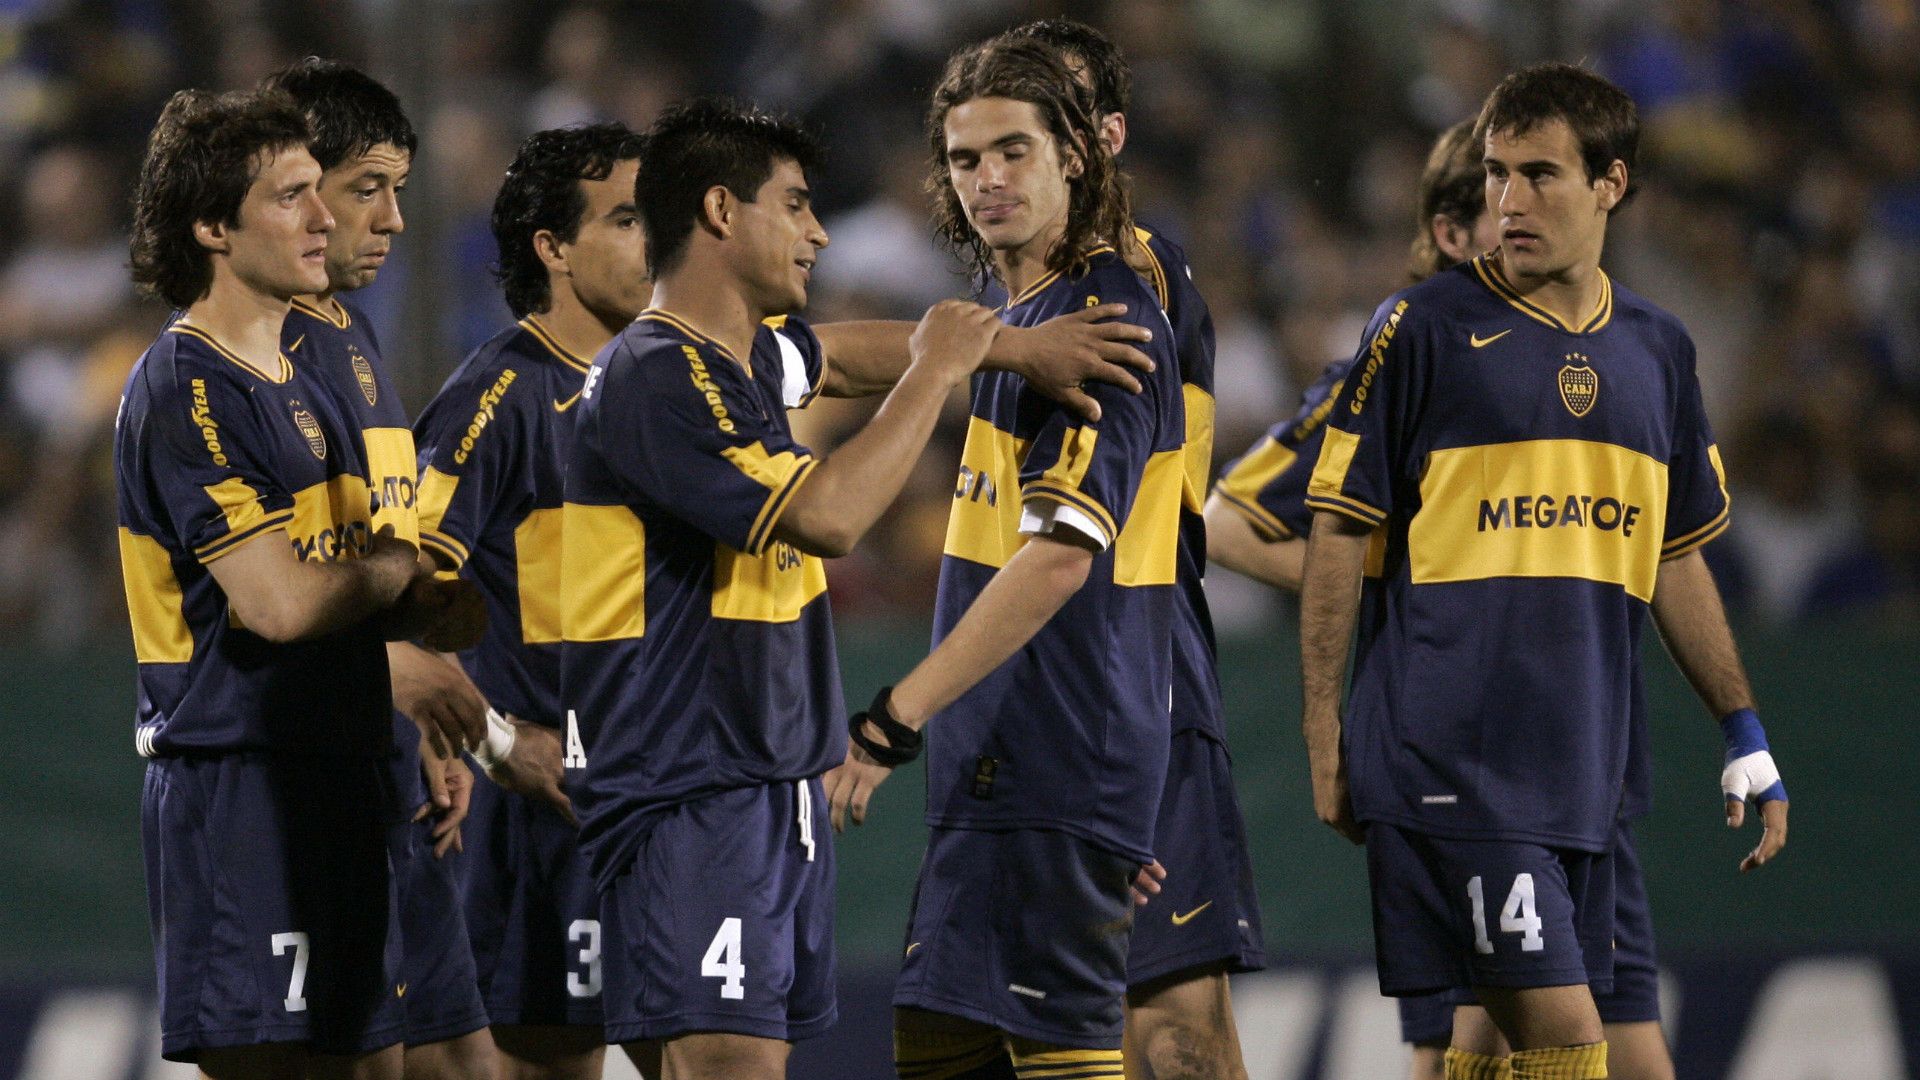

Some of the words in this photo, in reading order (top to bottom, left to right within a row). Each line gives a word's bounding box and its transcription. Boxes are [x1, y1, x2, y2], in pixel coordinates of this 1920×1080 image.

[682, 344, 739, 434] OODYEAR
[1350, 300, 1409, 415] GOODYEAR
[1565, 383, 1592, 395] CABJ
[191, 378, 231, 468] OODYEAR
[454, 368, 517, 464] GOODYEAR
[370, 475, 418, 517] ATO
[1477, 494, 1642, 538] MEGATOE
[562, 709, 588, 769] A
[1466, 872, 1545, 955] 14
[271, 932, 310, 1012] 7
[567, 919, 602, 998] 3
[701, 917, 746, 999] 4
